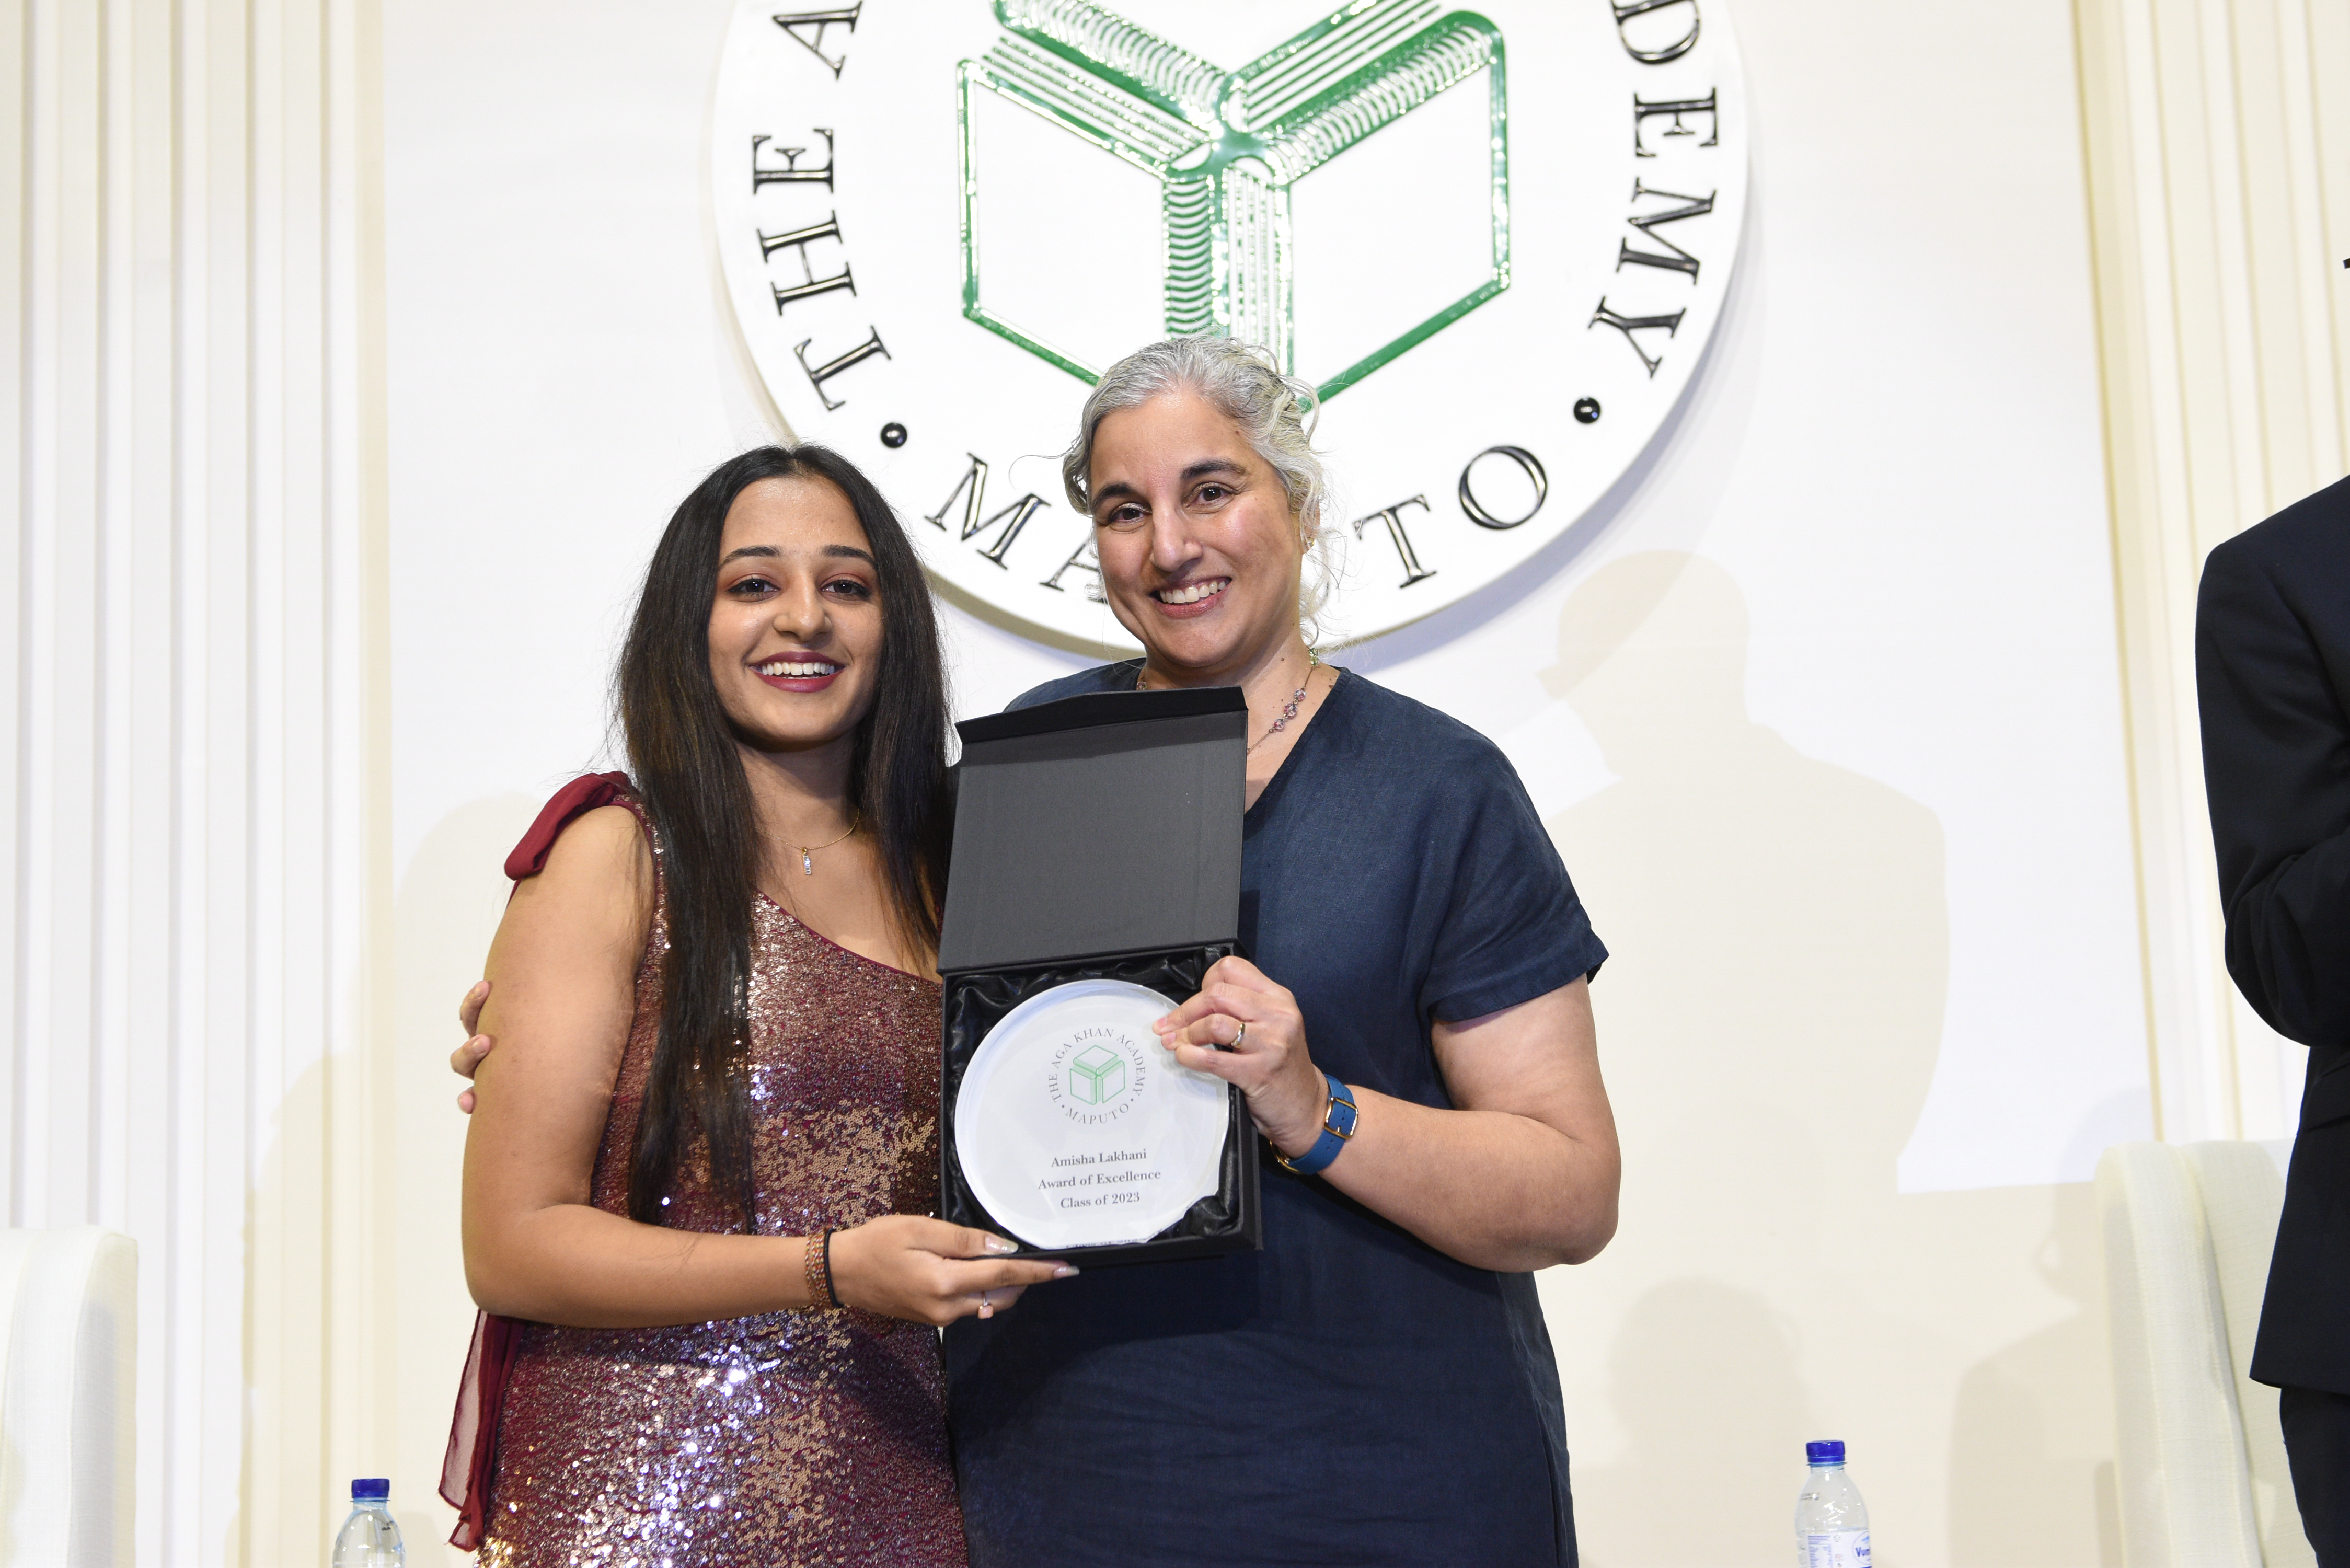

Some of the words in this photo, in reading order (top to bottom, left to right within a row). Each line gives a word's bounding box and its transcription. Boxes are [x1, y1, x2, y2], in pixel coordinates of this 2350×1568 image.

[752, 128, 892, 411] THE
[1074, 1028, 1114, 1043] KHAN
[1051, 1043, 1072, 1069] AGA
[1116, 1034, 1146, 1097] ACADEMY
[1048, 1073, 1062, 1103] THE
[1065, 1103, 1129, 1125] MAPUTO
[1051, 1155, 1095, 1167] Amisha
[1099, 1149, 1147, 1163] Lakhani
[1038, 1177, 1076, 1190] Award
[1079, 1174, 1093, 1186] of
[1097, 1171, 1161, 1184] Excellence
[1060, 1197, 1091, 1209] Class
[1095, 1195, 1109, 1206] of
[1111, 1191, 1140, 1204] 2023
